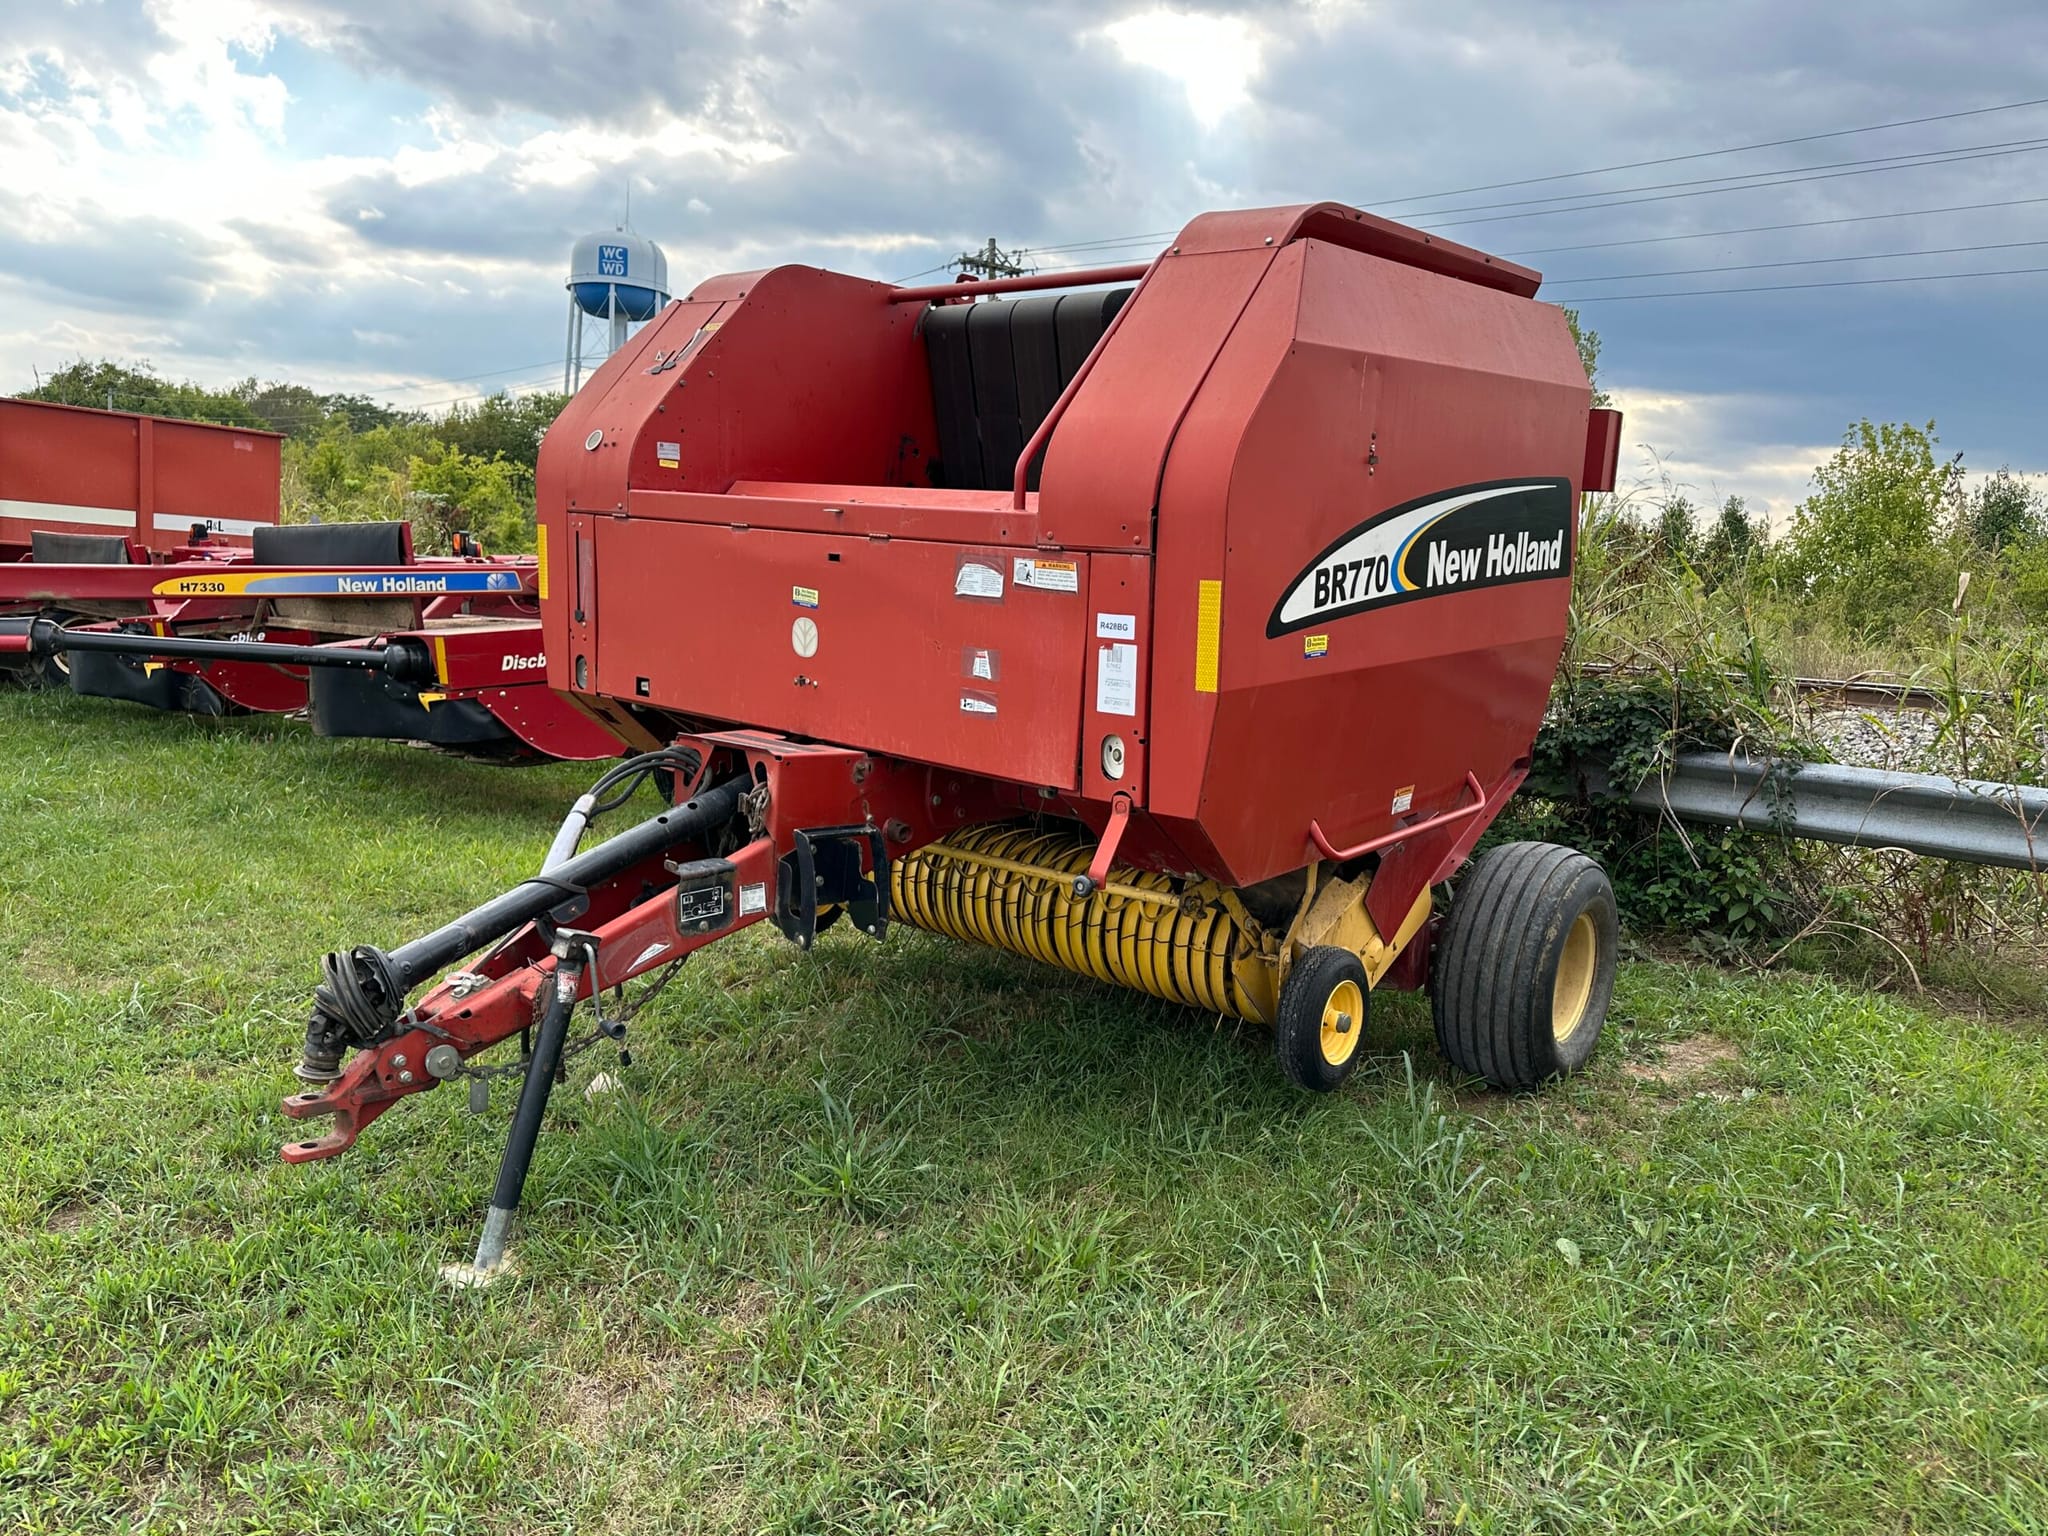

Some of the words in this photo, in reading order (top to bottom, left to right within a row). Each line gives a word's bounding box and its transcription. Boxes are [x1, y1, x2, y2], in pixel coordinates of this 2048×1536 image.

[602, 246, 623, 260] WC
[602, 262, 624, 276] WD
[1314, 555, 1388, 608] BR770
[1427, 540, 1482, 587] New
[1486, 530, 1563, 576] Holland
[180, 582, 225, 593] H7330
[337, 577, 378, 593] New
[382, 576, 447, 592] Holland
[1100, 621, 1129, 632] R428BG
[501, 652, 547, 672] Discb
